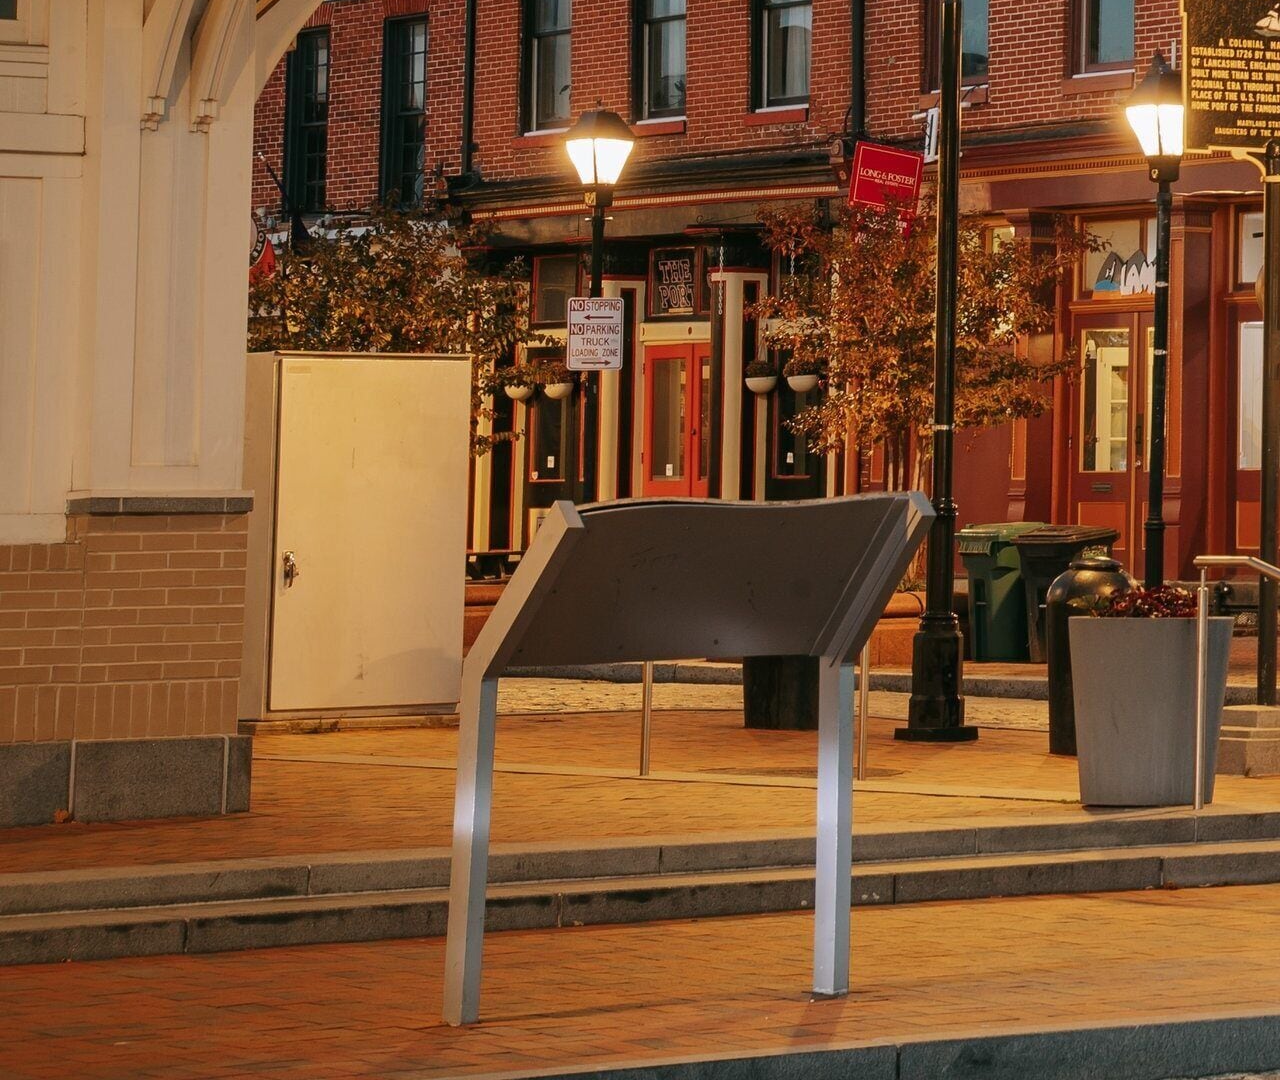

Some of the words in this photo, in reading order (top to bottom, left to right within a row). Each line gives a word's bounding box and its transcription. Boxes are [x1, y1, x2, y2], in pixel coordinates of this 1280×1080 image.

[1219, 38, 1224, 47] A
[1228, 38, 1264, 49] COLONIAL
[1191, 46, 1235, 58] ESTABLISHED
[1236, 49, 1253, 59] 1726
[1254, 50, 1263, 59] BY
[1191, 58, 1200, 67] OF
[1191, 68, 1210, 78] BUILT
[1211, 69, 1229, 79] MORE
[1231, 70, 1249, 80] THAN
[1251, 71, 1263, 80] SIX
[1191, 80, 1224, 89] COLONIAL
[1226, 81, 1241, 90] ERA
[1243, 82, 1273, 92] THROUGH
[1191, 90, 1212, 100] PLACE
[1213, 91, 1222, 100] OF
[1225, 91, 1238, 100] THE
[1191, 101, 1210, 110] HOME
[1211, 102, 1228, 111] PORT
[1230, 103, 1238, 111] OF
[1241, 103, 1253, 112] THE
[1255, 104, 1280, 114] FAMOUS
[1237, 119, 1266, 127] MARYLAND
[1215, 127, 1247, 136] DAUGHTERS
[1261, 129, 1272, 137] THE
[860, 168, 881, 179] LONG
[887, 173, 915, 185] FOSTER
[659, 259, 692, 284] THE
[571, 300, 584, 311] NO
[586, 301, 620, 311] STOPPING
[571, 324, 584, 334] NO
[586, 325, 620, 335] PARKING
[581, 337, 610, 346] TRUCK
[571, 348, 599, 357] LOADING
[602, 348, 619, 357] ZONE
